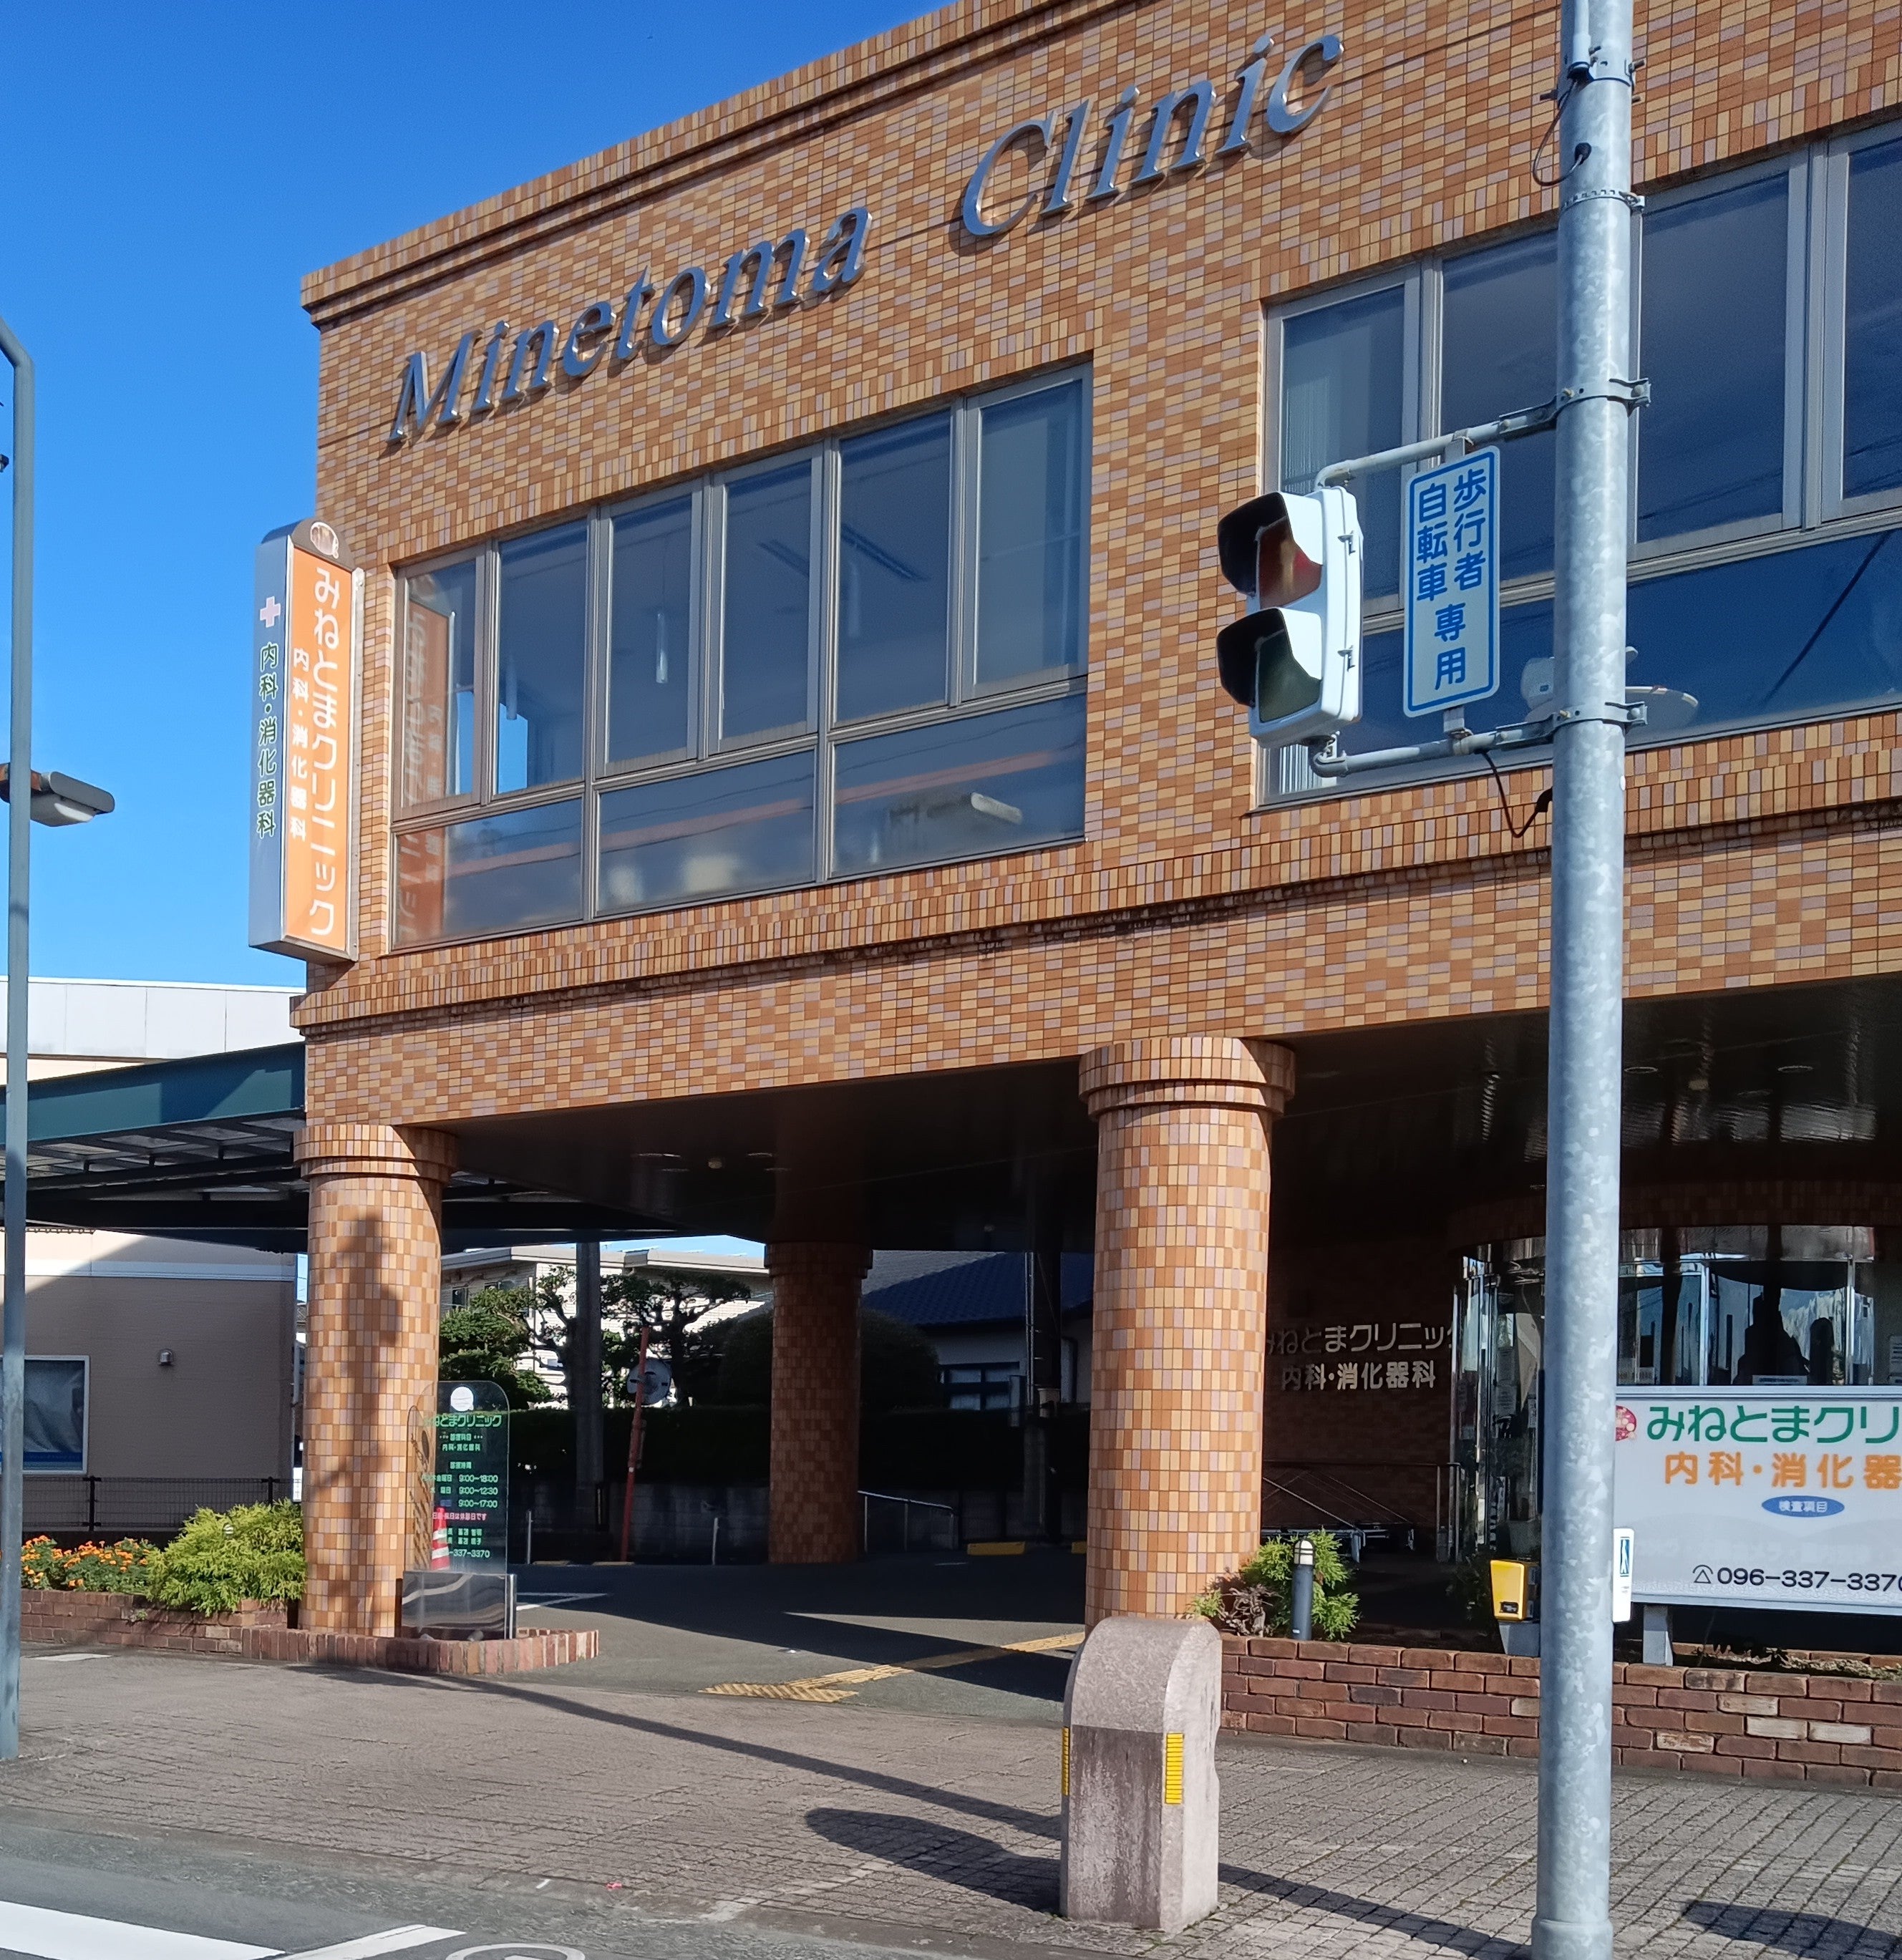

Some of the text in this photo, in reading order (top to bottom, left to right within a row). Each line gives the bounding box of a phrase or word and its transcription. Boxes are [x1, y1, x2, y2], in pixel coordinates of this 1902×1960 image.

[387, 34, 1344, 445] Minetoma Clinic
[1416, 482, 1448, 602] 自転車
[1453, 467, 1487, 592] 歩行者
[1434, 602, 1466, 691] 専用
[256, 641, 279, 840] 内科・消化器科
[289, 646, 310, 843] 内科・消化器科
[309, 566, 341, 936] みねとまクリニック
[1267, 1323, 1452, 1355] ねとまクリニッ
[1282, 1359, 1436, 1391] 内科・消化器科
[424, 1414, 502, 1427] ねとまクリニック
[1646, 1404, 1900, 1444] みねとまクリ
[1664, 1450, 1902, 1490] 内科・消化器
